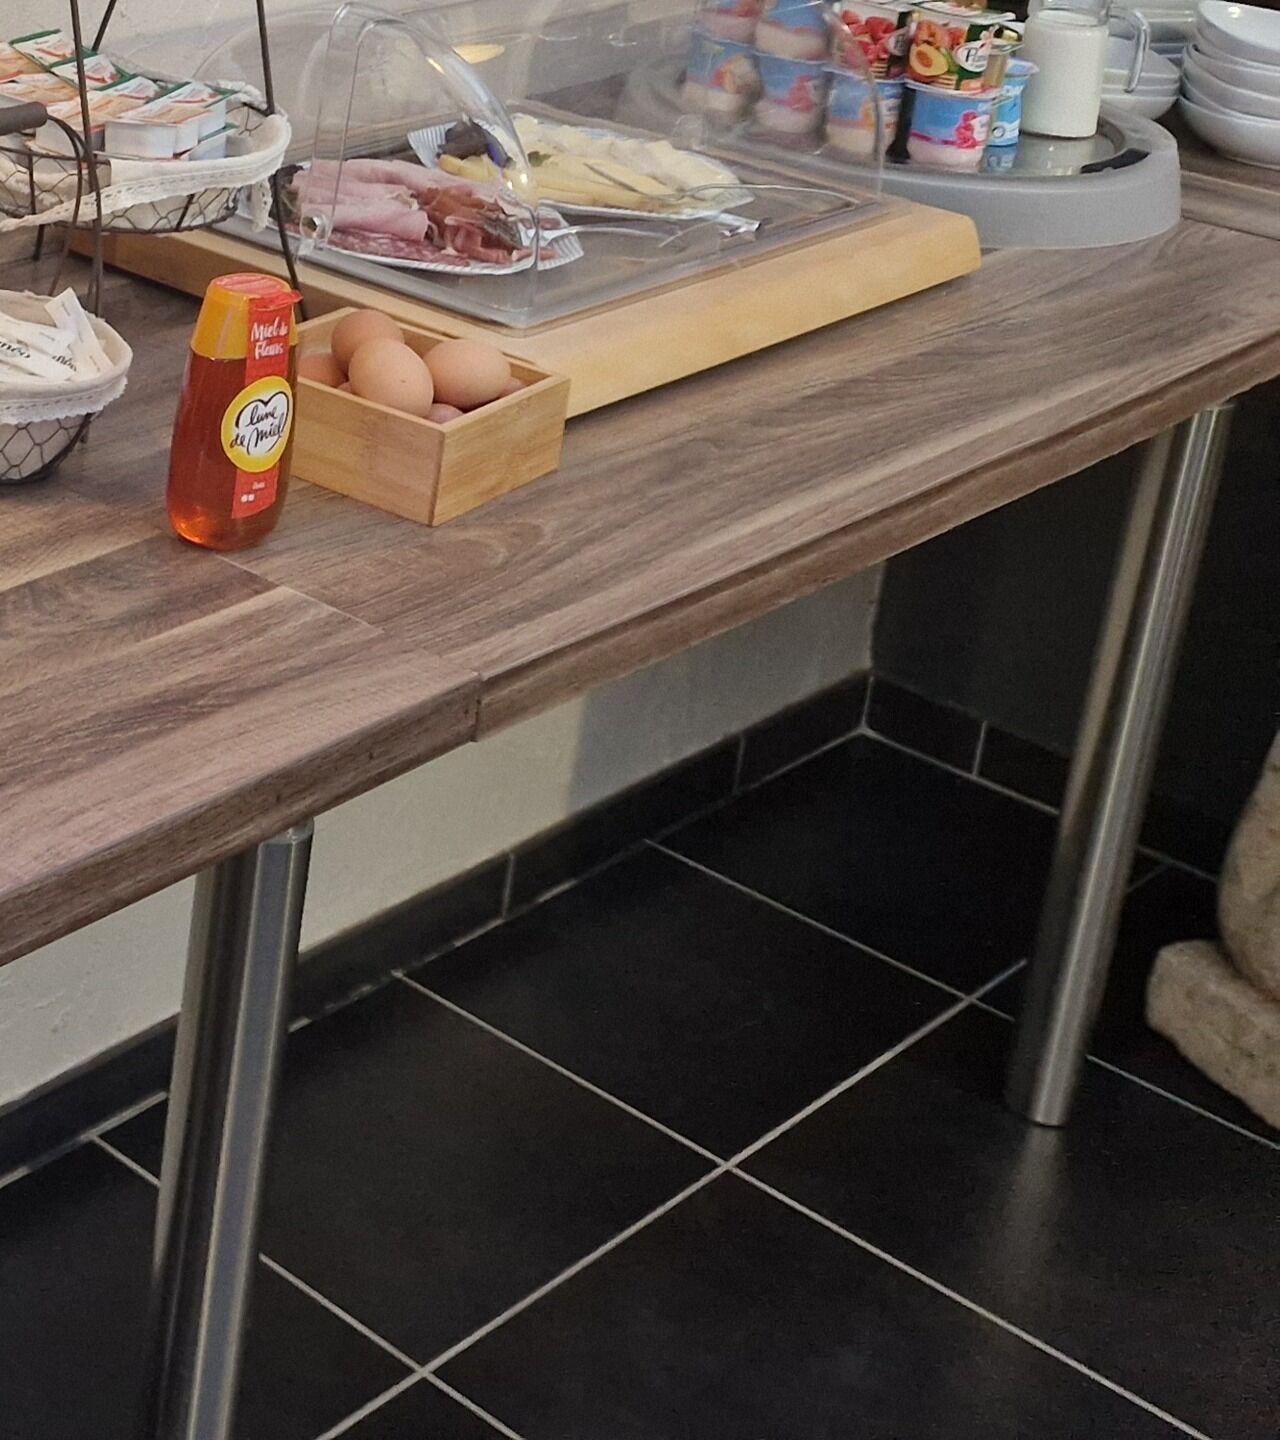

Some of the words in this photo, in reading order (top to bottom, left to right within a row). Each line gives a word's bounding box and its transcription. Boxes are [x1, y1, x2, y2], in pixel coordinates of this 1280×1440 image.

[251, 316, 280, 342] Miel
[255, 340, 284, 360] Fleurs
[245, 404, 278, 427] lune
[230, 433, 245, 449] de
